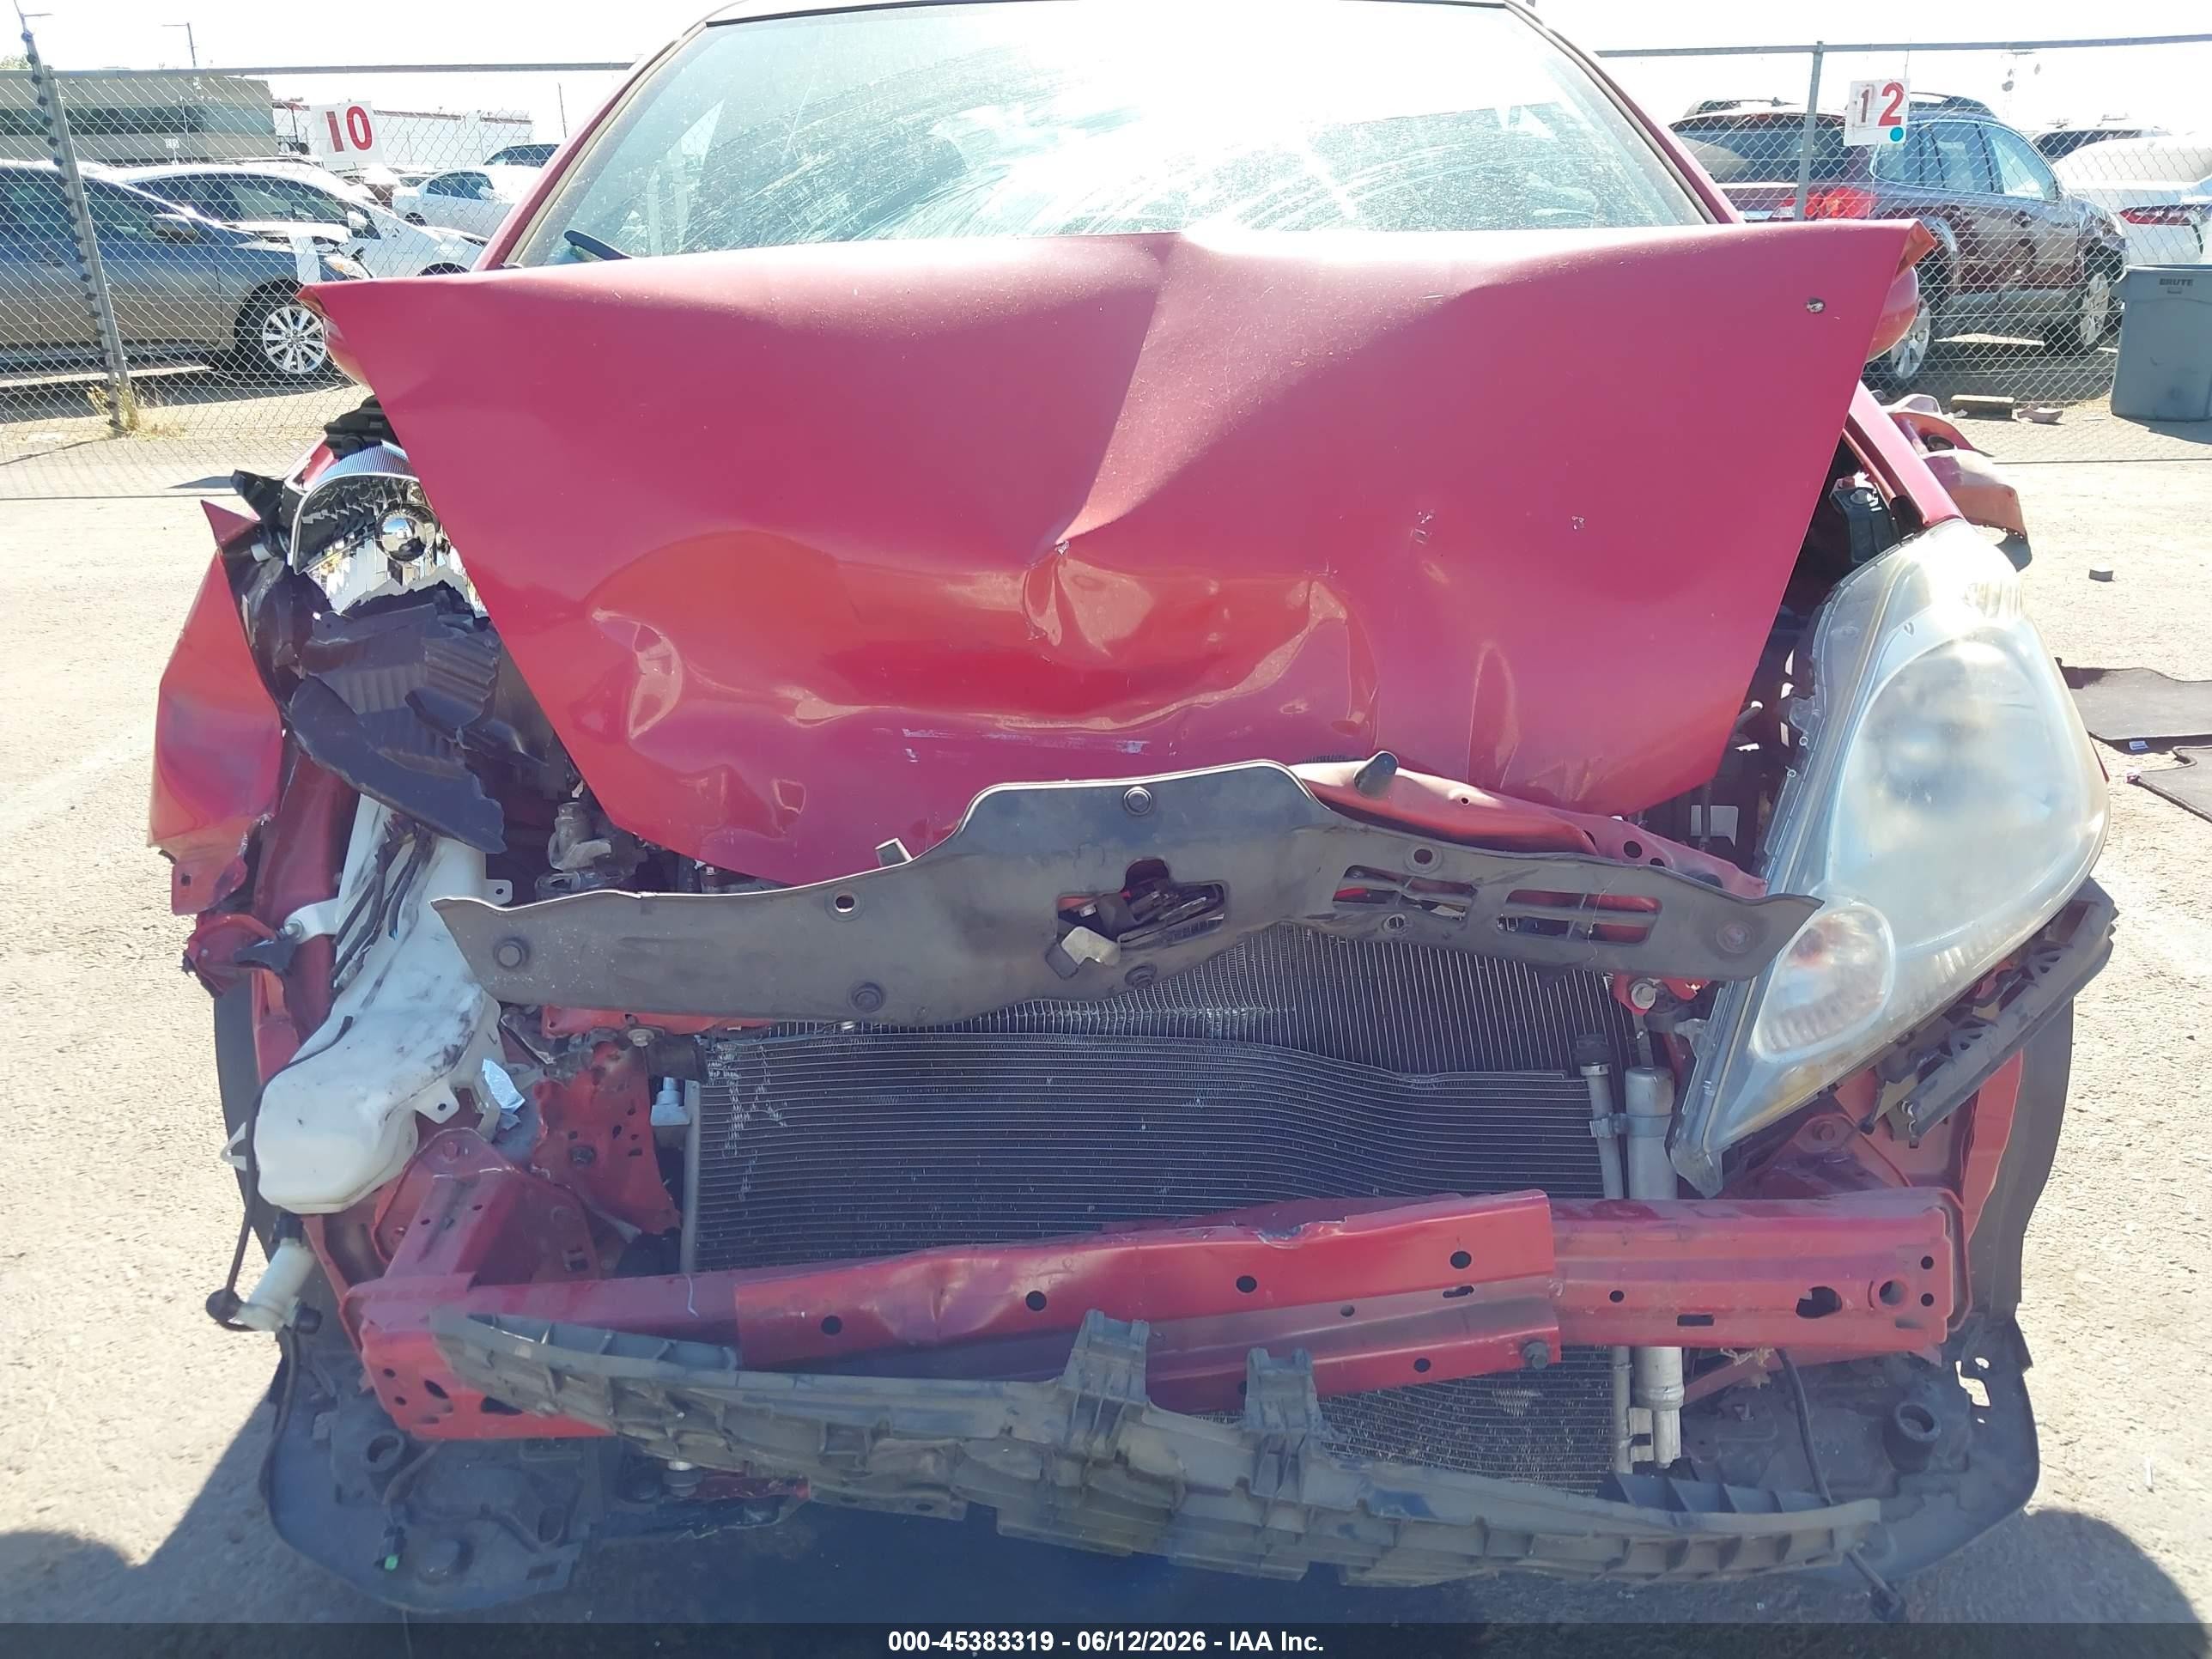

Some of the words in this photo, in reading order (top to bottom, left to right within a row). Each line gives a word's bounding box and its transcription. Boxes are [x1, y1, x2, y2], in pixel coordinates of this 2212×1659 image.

[1861, 82, 1905, 126] 12
[325, 106, 373, 152] 10
[2159, 277, 2194, 287] BRUTE
